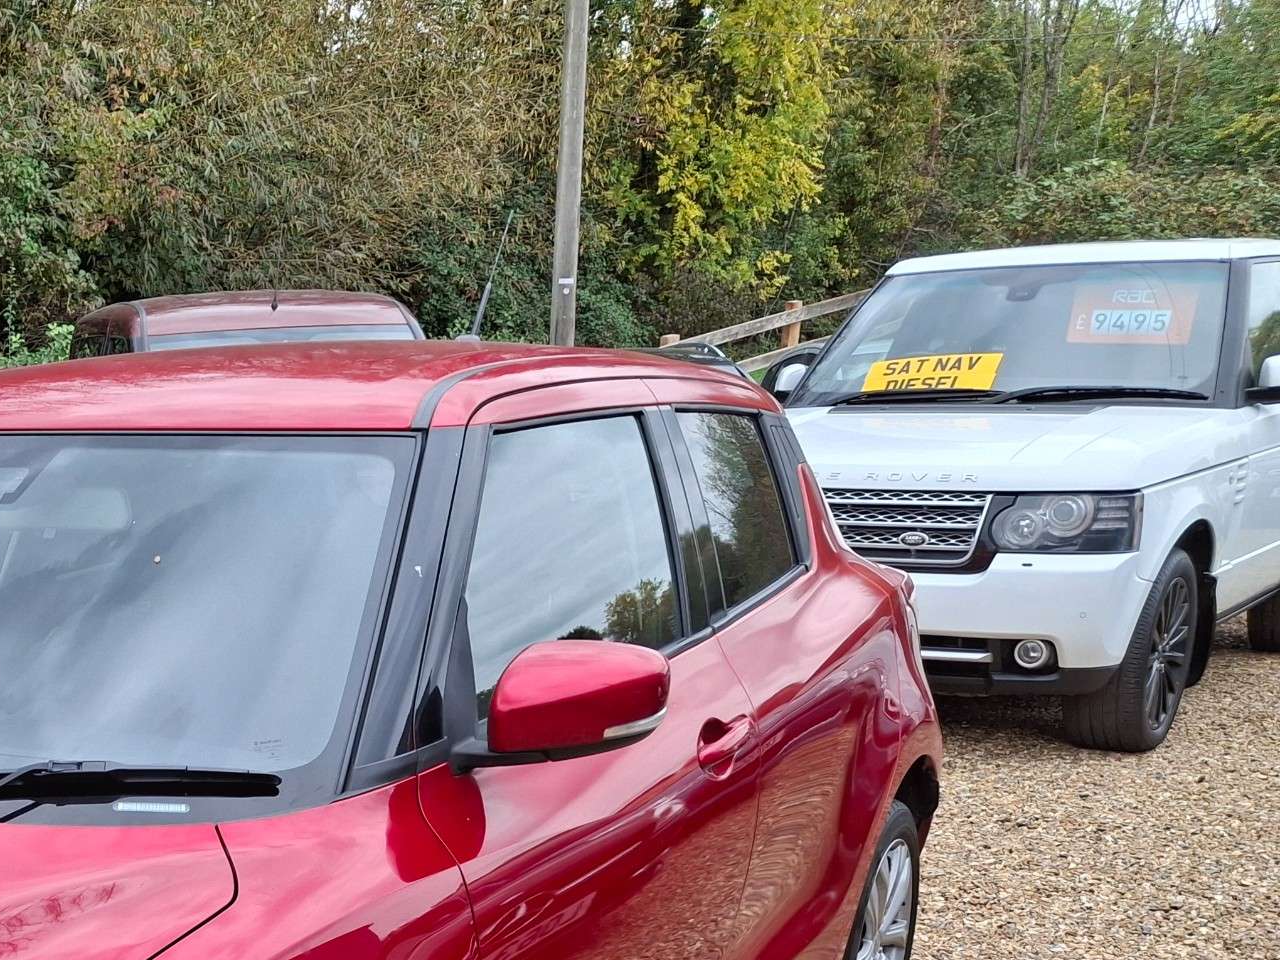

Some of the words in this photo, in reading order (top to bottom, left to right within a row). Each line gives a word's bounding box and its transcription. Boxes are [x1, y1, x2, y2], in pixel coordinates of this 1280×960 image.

[883, 358, 930, 376] SAT
[933, 356, 982, 373] NAV
[864, 472, 978, 483] ROVER
